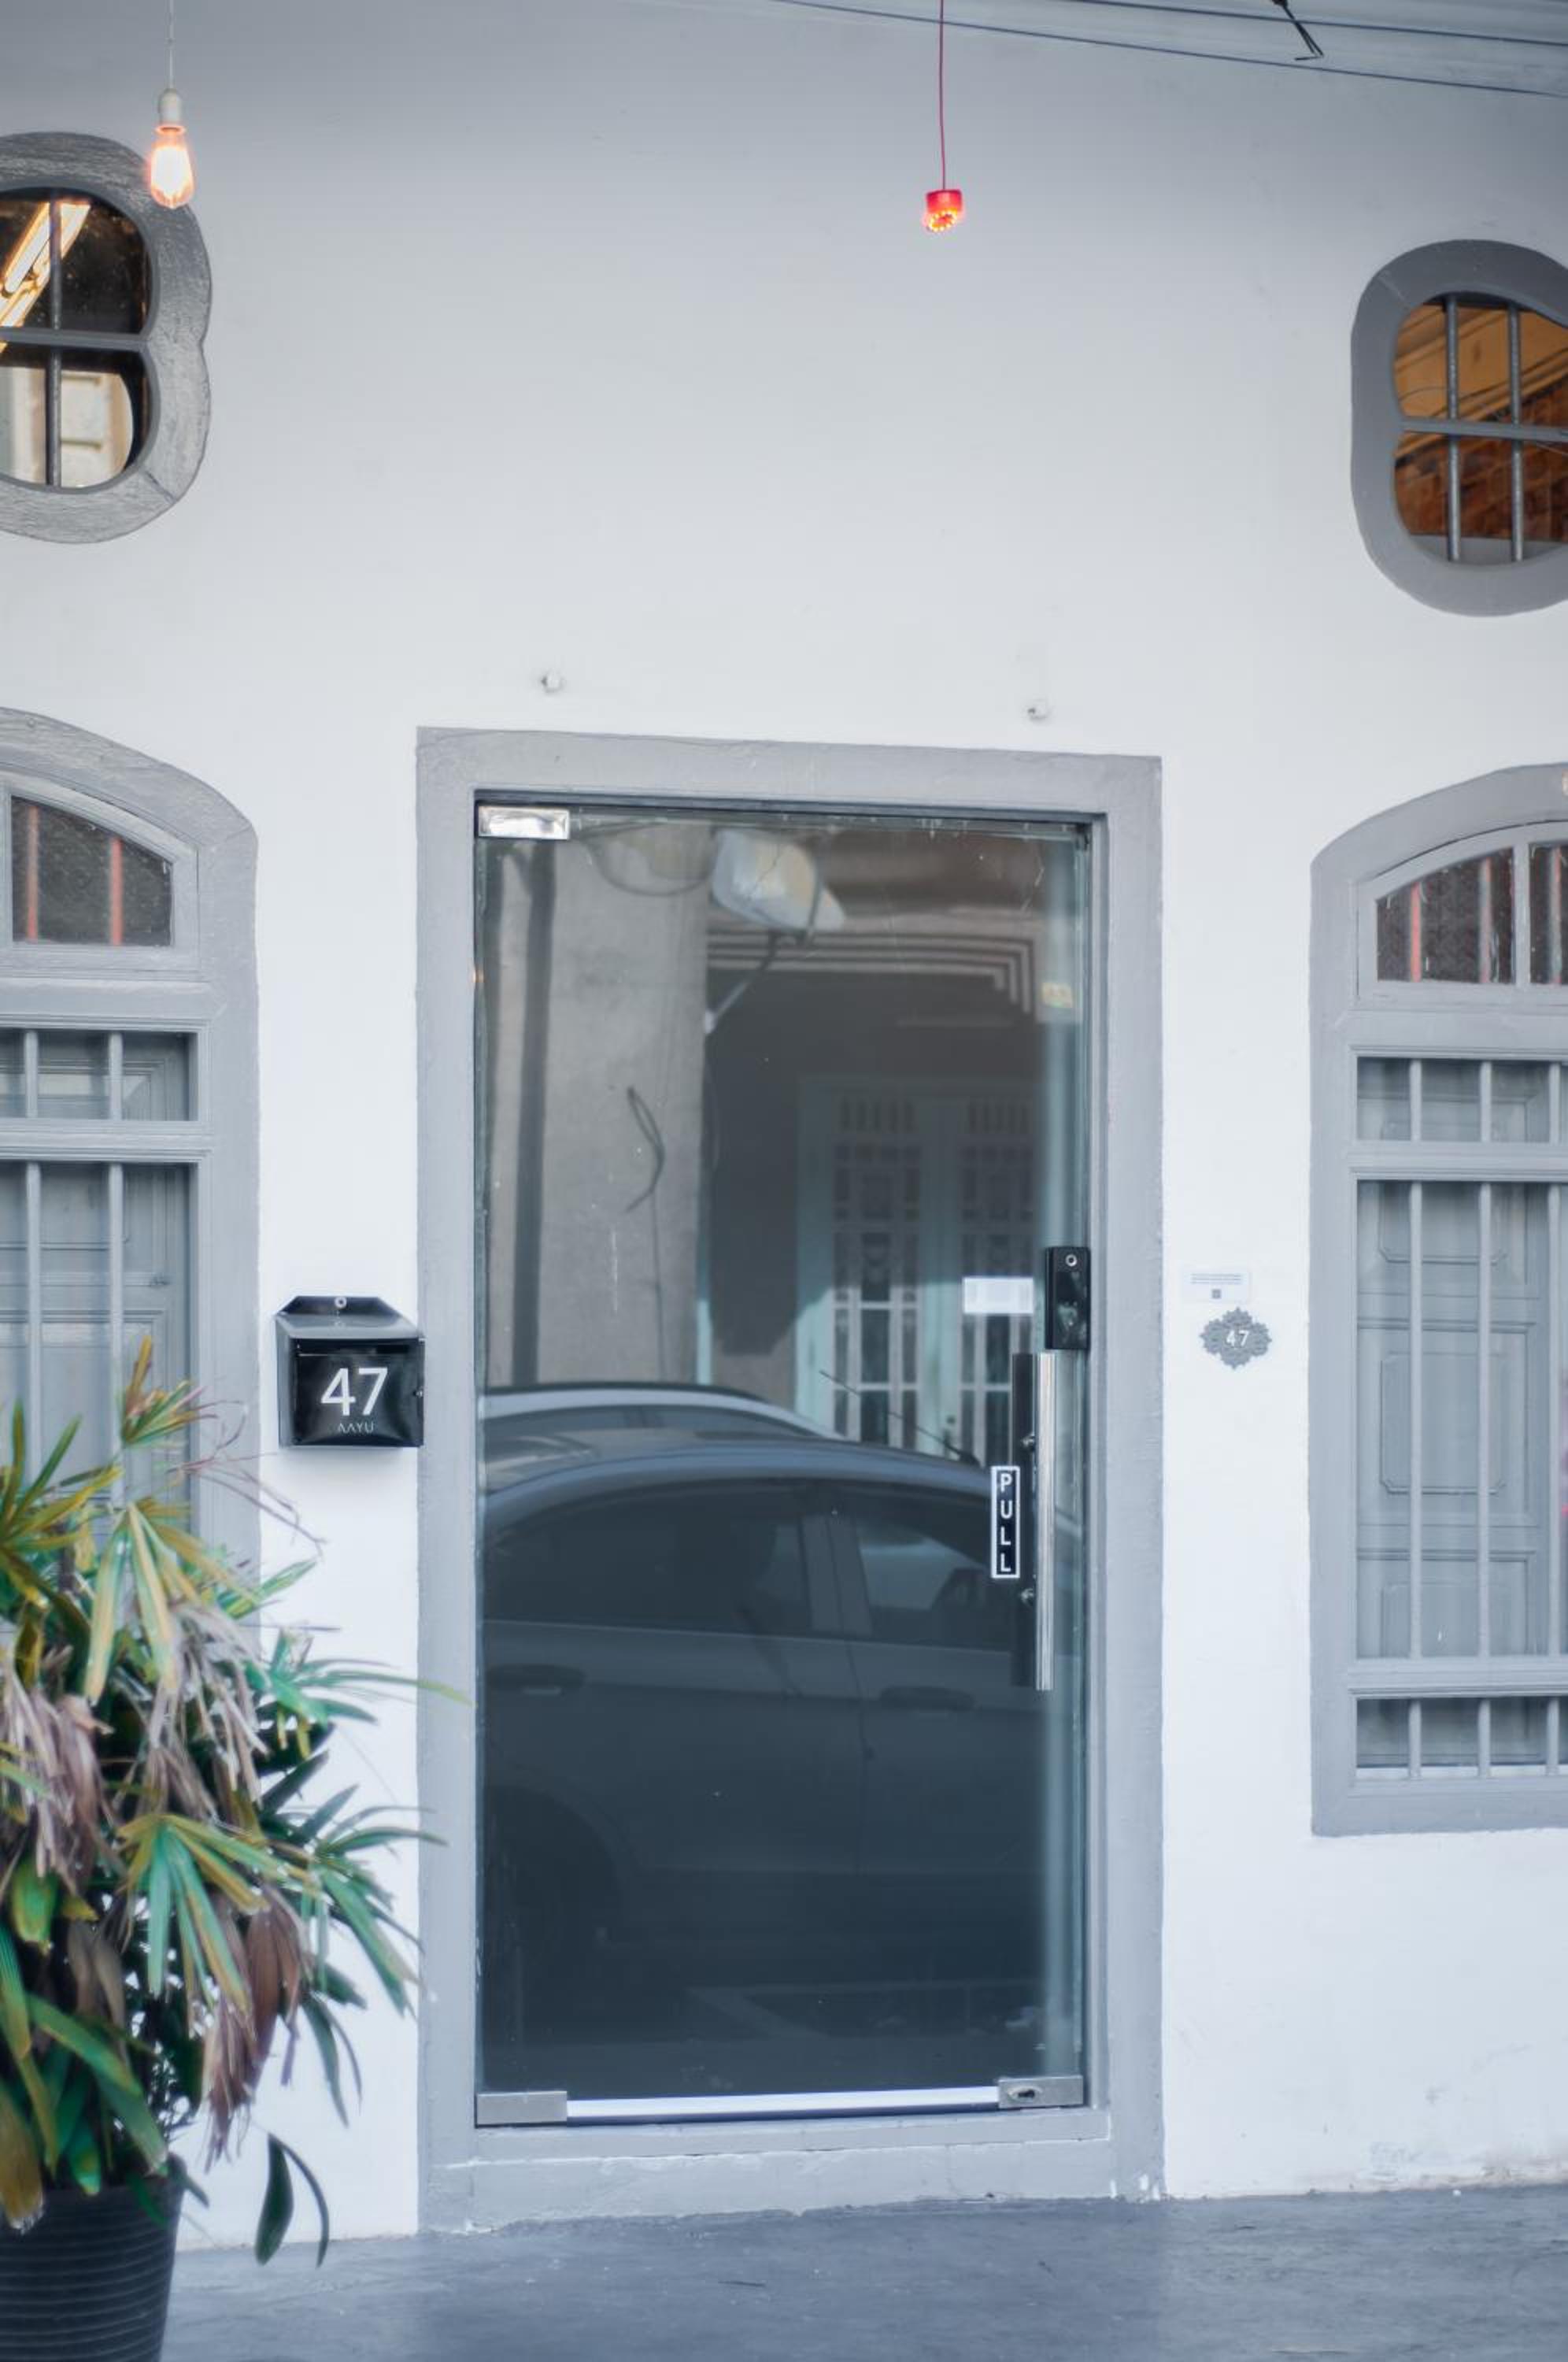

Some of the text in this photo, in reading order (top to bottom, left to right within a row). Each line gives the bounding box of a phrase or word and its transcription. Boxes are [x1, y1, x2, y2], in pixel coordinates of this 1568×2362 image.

[1226, 1330, 1249, 1347] 47
[320, 1368, 388, 1416] 47
[1000, 1473, 1013, 1572] PULL
